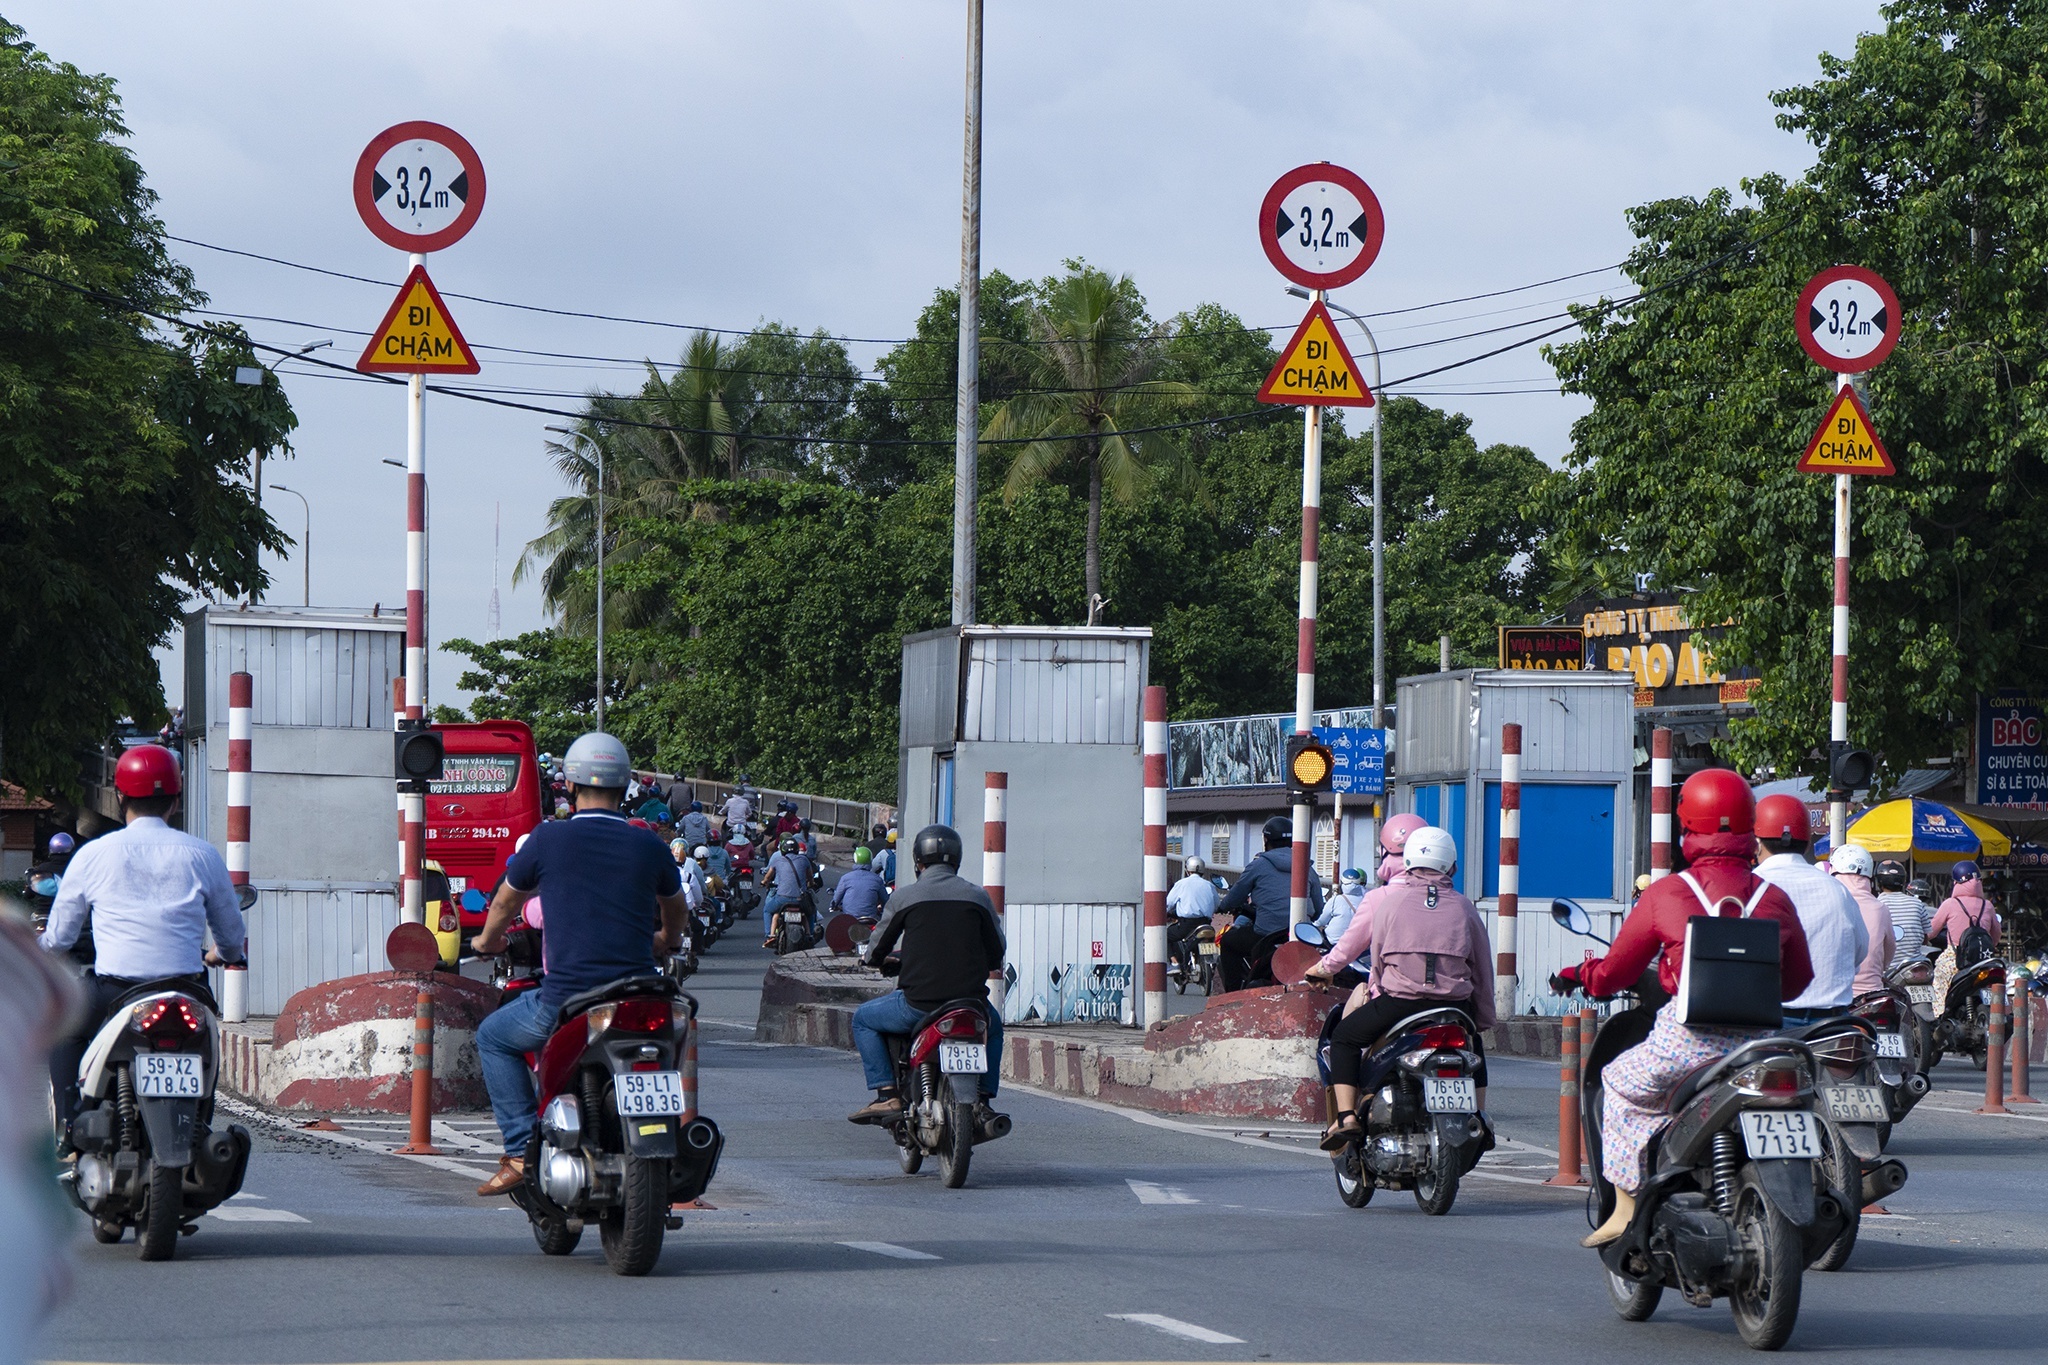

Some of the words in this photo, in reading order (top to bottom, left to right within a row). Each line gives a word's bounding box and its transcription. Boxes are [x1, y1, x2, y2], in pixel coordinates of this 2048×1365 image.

[408, 306, 431, 326] ĐI
[385, 332, 452, 362] CHẬM
[1306, 340, 1328, 360] ĐI
[1283, 366, 1348, 394] CHẬM
[1838, 418, 1856, 435] ĐI
[1819, 440, 1873, 464] CHẬM
[1510, 636, 1534, 655] VỰA
[1536, 634, 1556, 652] HẢI
[1558, 634, 1580, 652] SẢN
[1990, 697, 2014, 708] CÔNG
[2016, 698, 2026, 707] TY
[1992, 709, 2042, 746] BẢO
[486, 756, 497, 765] TẢI
[1988, 752, 2030, 768] CHUYÊN
[468, 766, 506, 781] CÔNG
[2000, 776, 2006, 790] &
[2025, 772, 2048, 789] TOÀ
[472, 827, 510, 839] 294.79
[1921, 826, 1964, 834] LARUE
[1093, 943, 1103, 956] 93
[1103, 969, 1125, 991] của
[1878, 1035, 1898, 1045] 4-K6
[947, 1046, 979, 1058] 79-L3
[1877, 1046, 1901, 1055] 264
[148, 1058, 192, 1075] 59-X2
[949, 1059, 979, 1070] 4064
[142, 1076, 199, 1093] 718.49
[626, 1075, 670, 1092] 59-L1
[1433, 1080, 1466, 1094] 76-G1
[624, 1094, 680, 1113] 498.36
[1431, 1096, 1472, 1110] 136.21
[1832, 1088, 1875, 1103] 37-B1
[1832, 1105, 1884, 1119] 698.13
[1753, 1114, 1806, 1132] 72-L3
[1758, 1135, 1811, 1154] 7134
